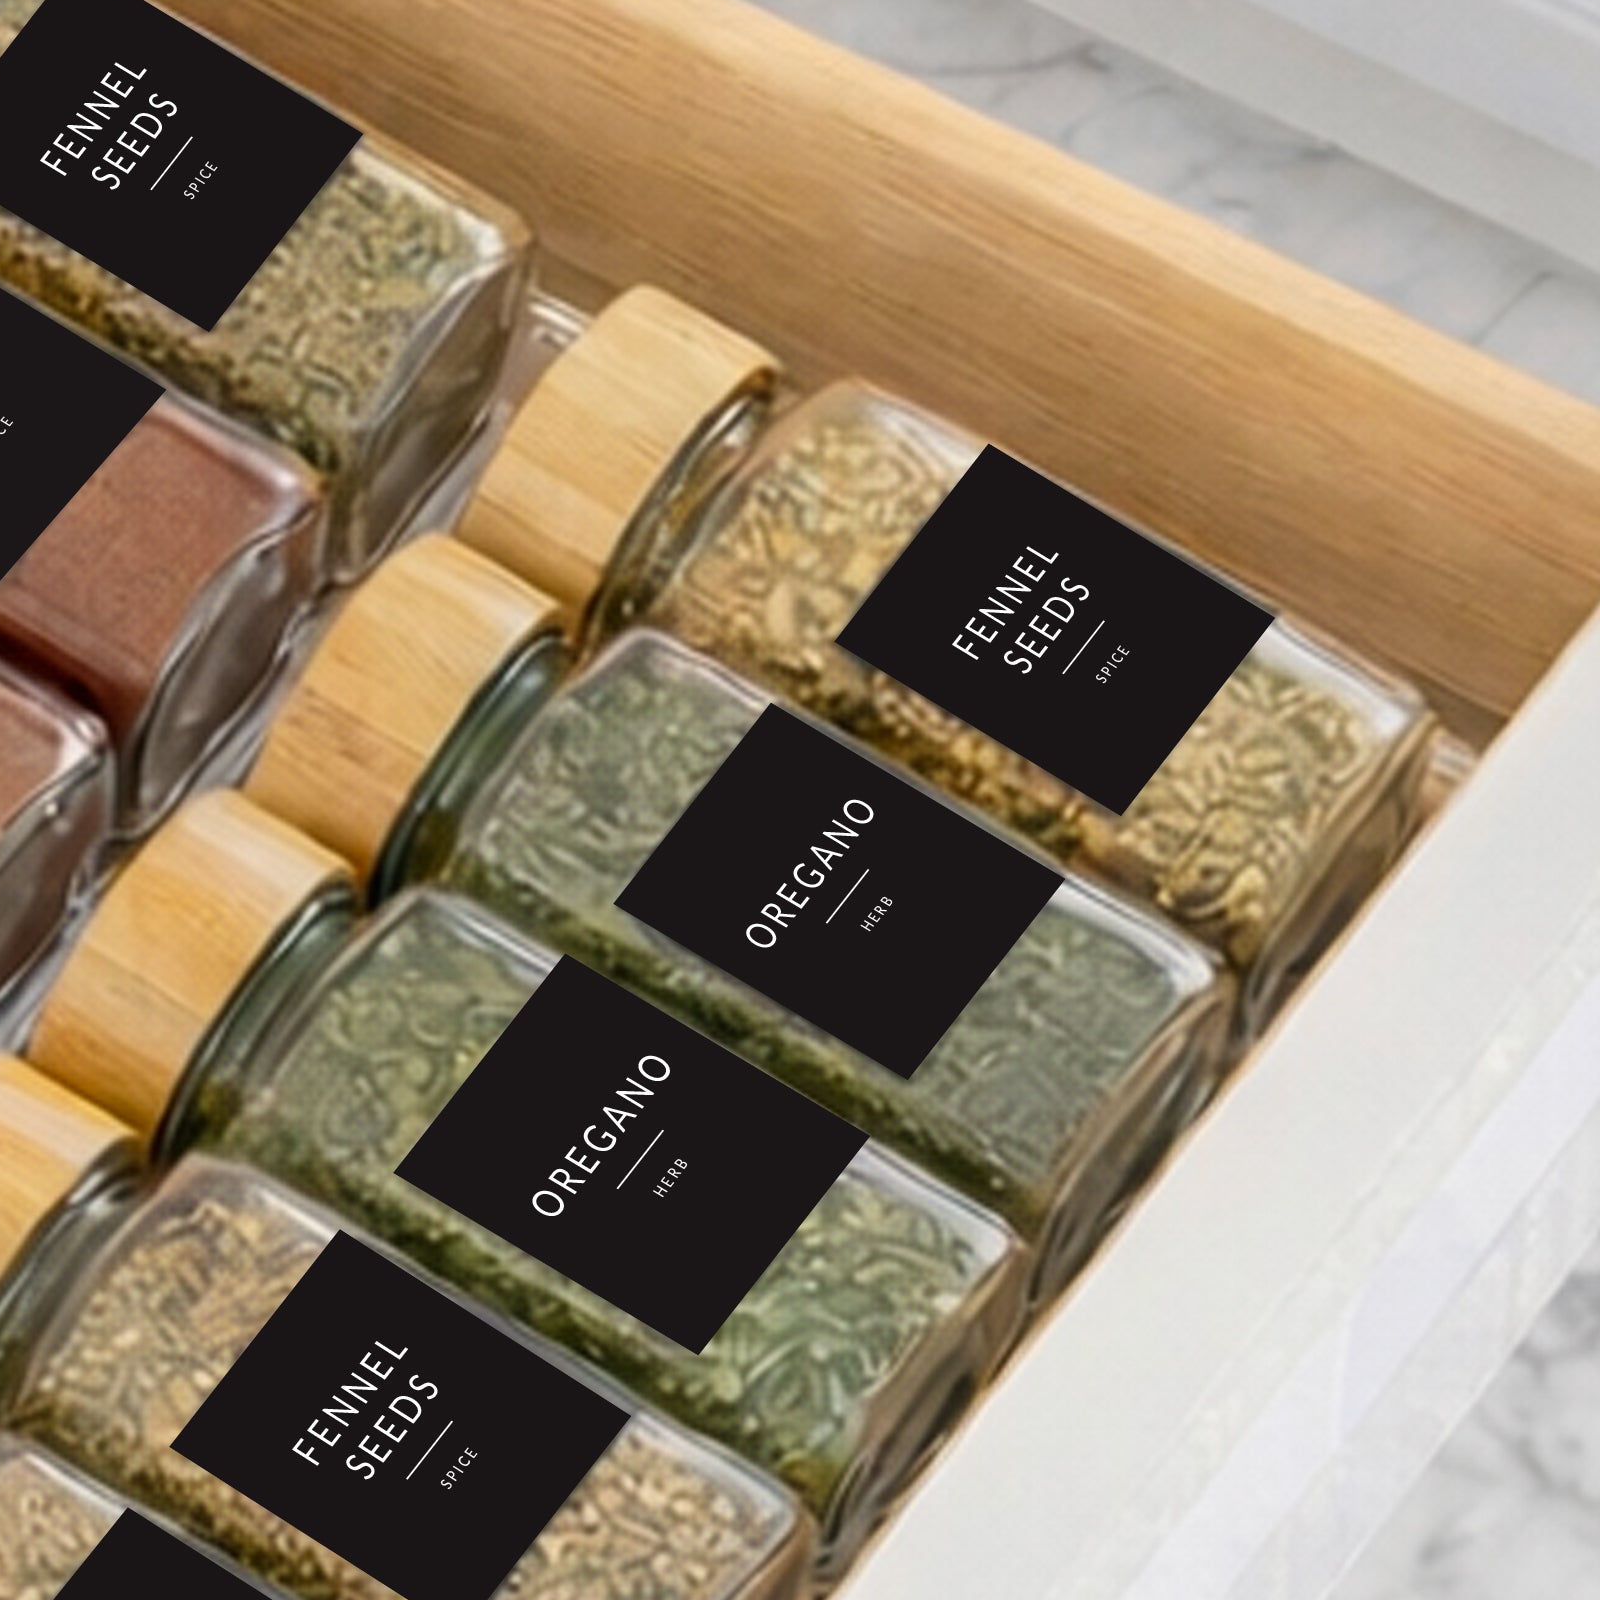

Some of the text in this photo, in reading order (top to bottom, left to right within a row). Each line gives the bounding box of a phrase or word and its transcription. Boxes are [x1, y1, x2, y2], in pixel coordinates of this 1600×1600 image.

[40, 62, 147, 176] FENNEL
[92, 93, 177, 190] SEEDS
[184, 161, 218, 199] SPICE
[952, 546, 1059, 660] FENNEL
[1004, 577, 1089, 674] SEEDS
[1096, 645, 1130, 683] SPICE
[746, 799, 874, 948] OREGANO
[860, 897, 892, 931] HERB
[532, 1055, 670, 1216] OREGANO
[653, 1159, 687, 1197] HERB
[292, 1341, 408, 1466] FENNEL
[346, 1375, 438, 1480] SEEDS
[441, 1448, 477, 1489] SPICE
